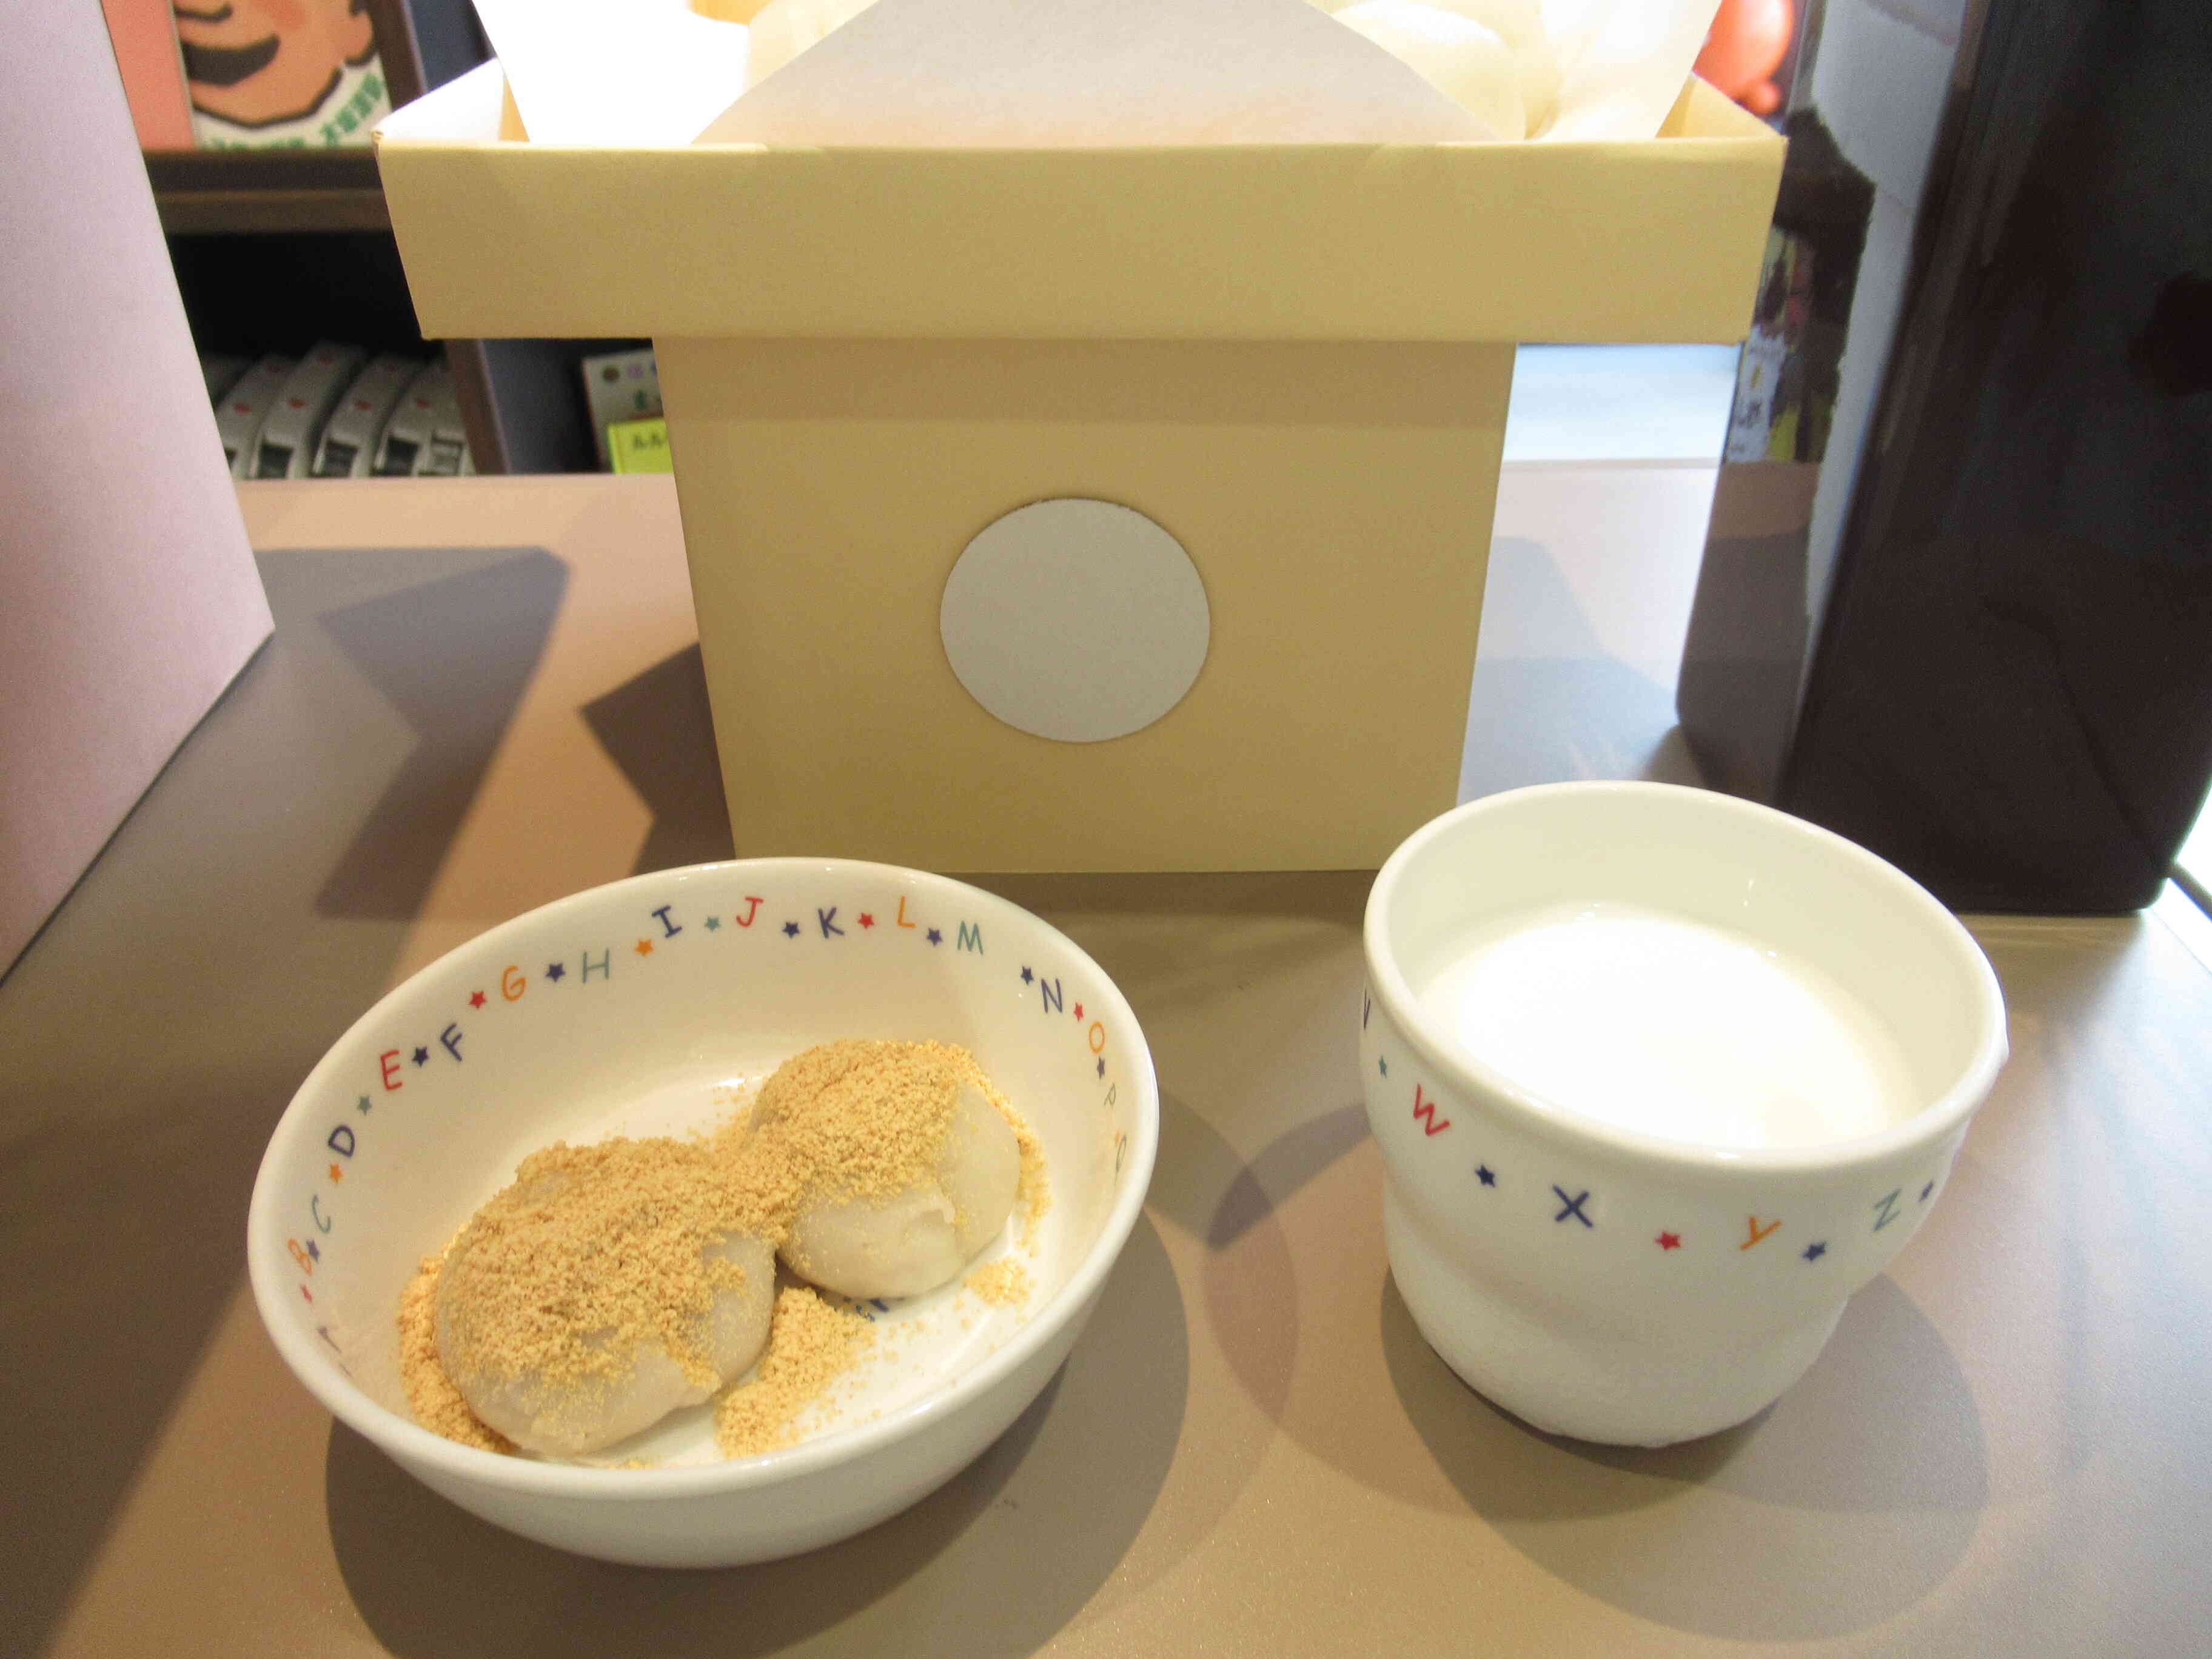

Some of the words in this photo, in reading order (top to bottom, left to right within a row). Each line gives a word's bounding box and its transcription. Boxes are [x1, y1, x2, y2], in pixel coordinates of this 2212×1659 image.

[310, 1194, 332, 1235] C
[327, 1124, 355, 1158] D
[380, 1049, 403, 1091] E
[440, 1023, 463, 1062] F
[501, 965, 527, 1002] G
[582, 948, 610, 984] H
[651, 905, 683, 939] I
[736, 896, 764, 928] J
[817, 907, 845, 939] K
[897, 896, 916, 929] L
[957, 920, 984, 955] M
[1041, 978, 1063, 1013] N
[1088, 1021, 1106, 1054] O
[1413, 1083, 1451, 1138] W
[1552, 1185, 1594, 1228] X
[1872, 1188, 1902, 1233] Z
